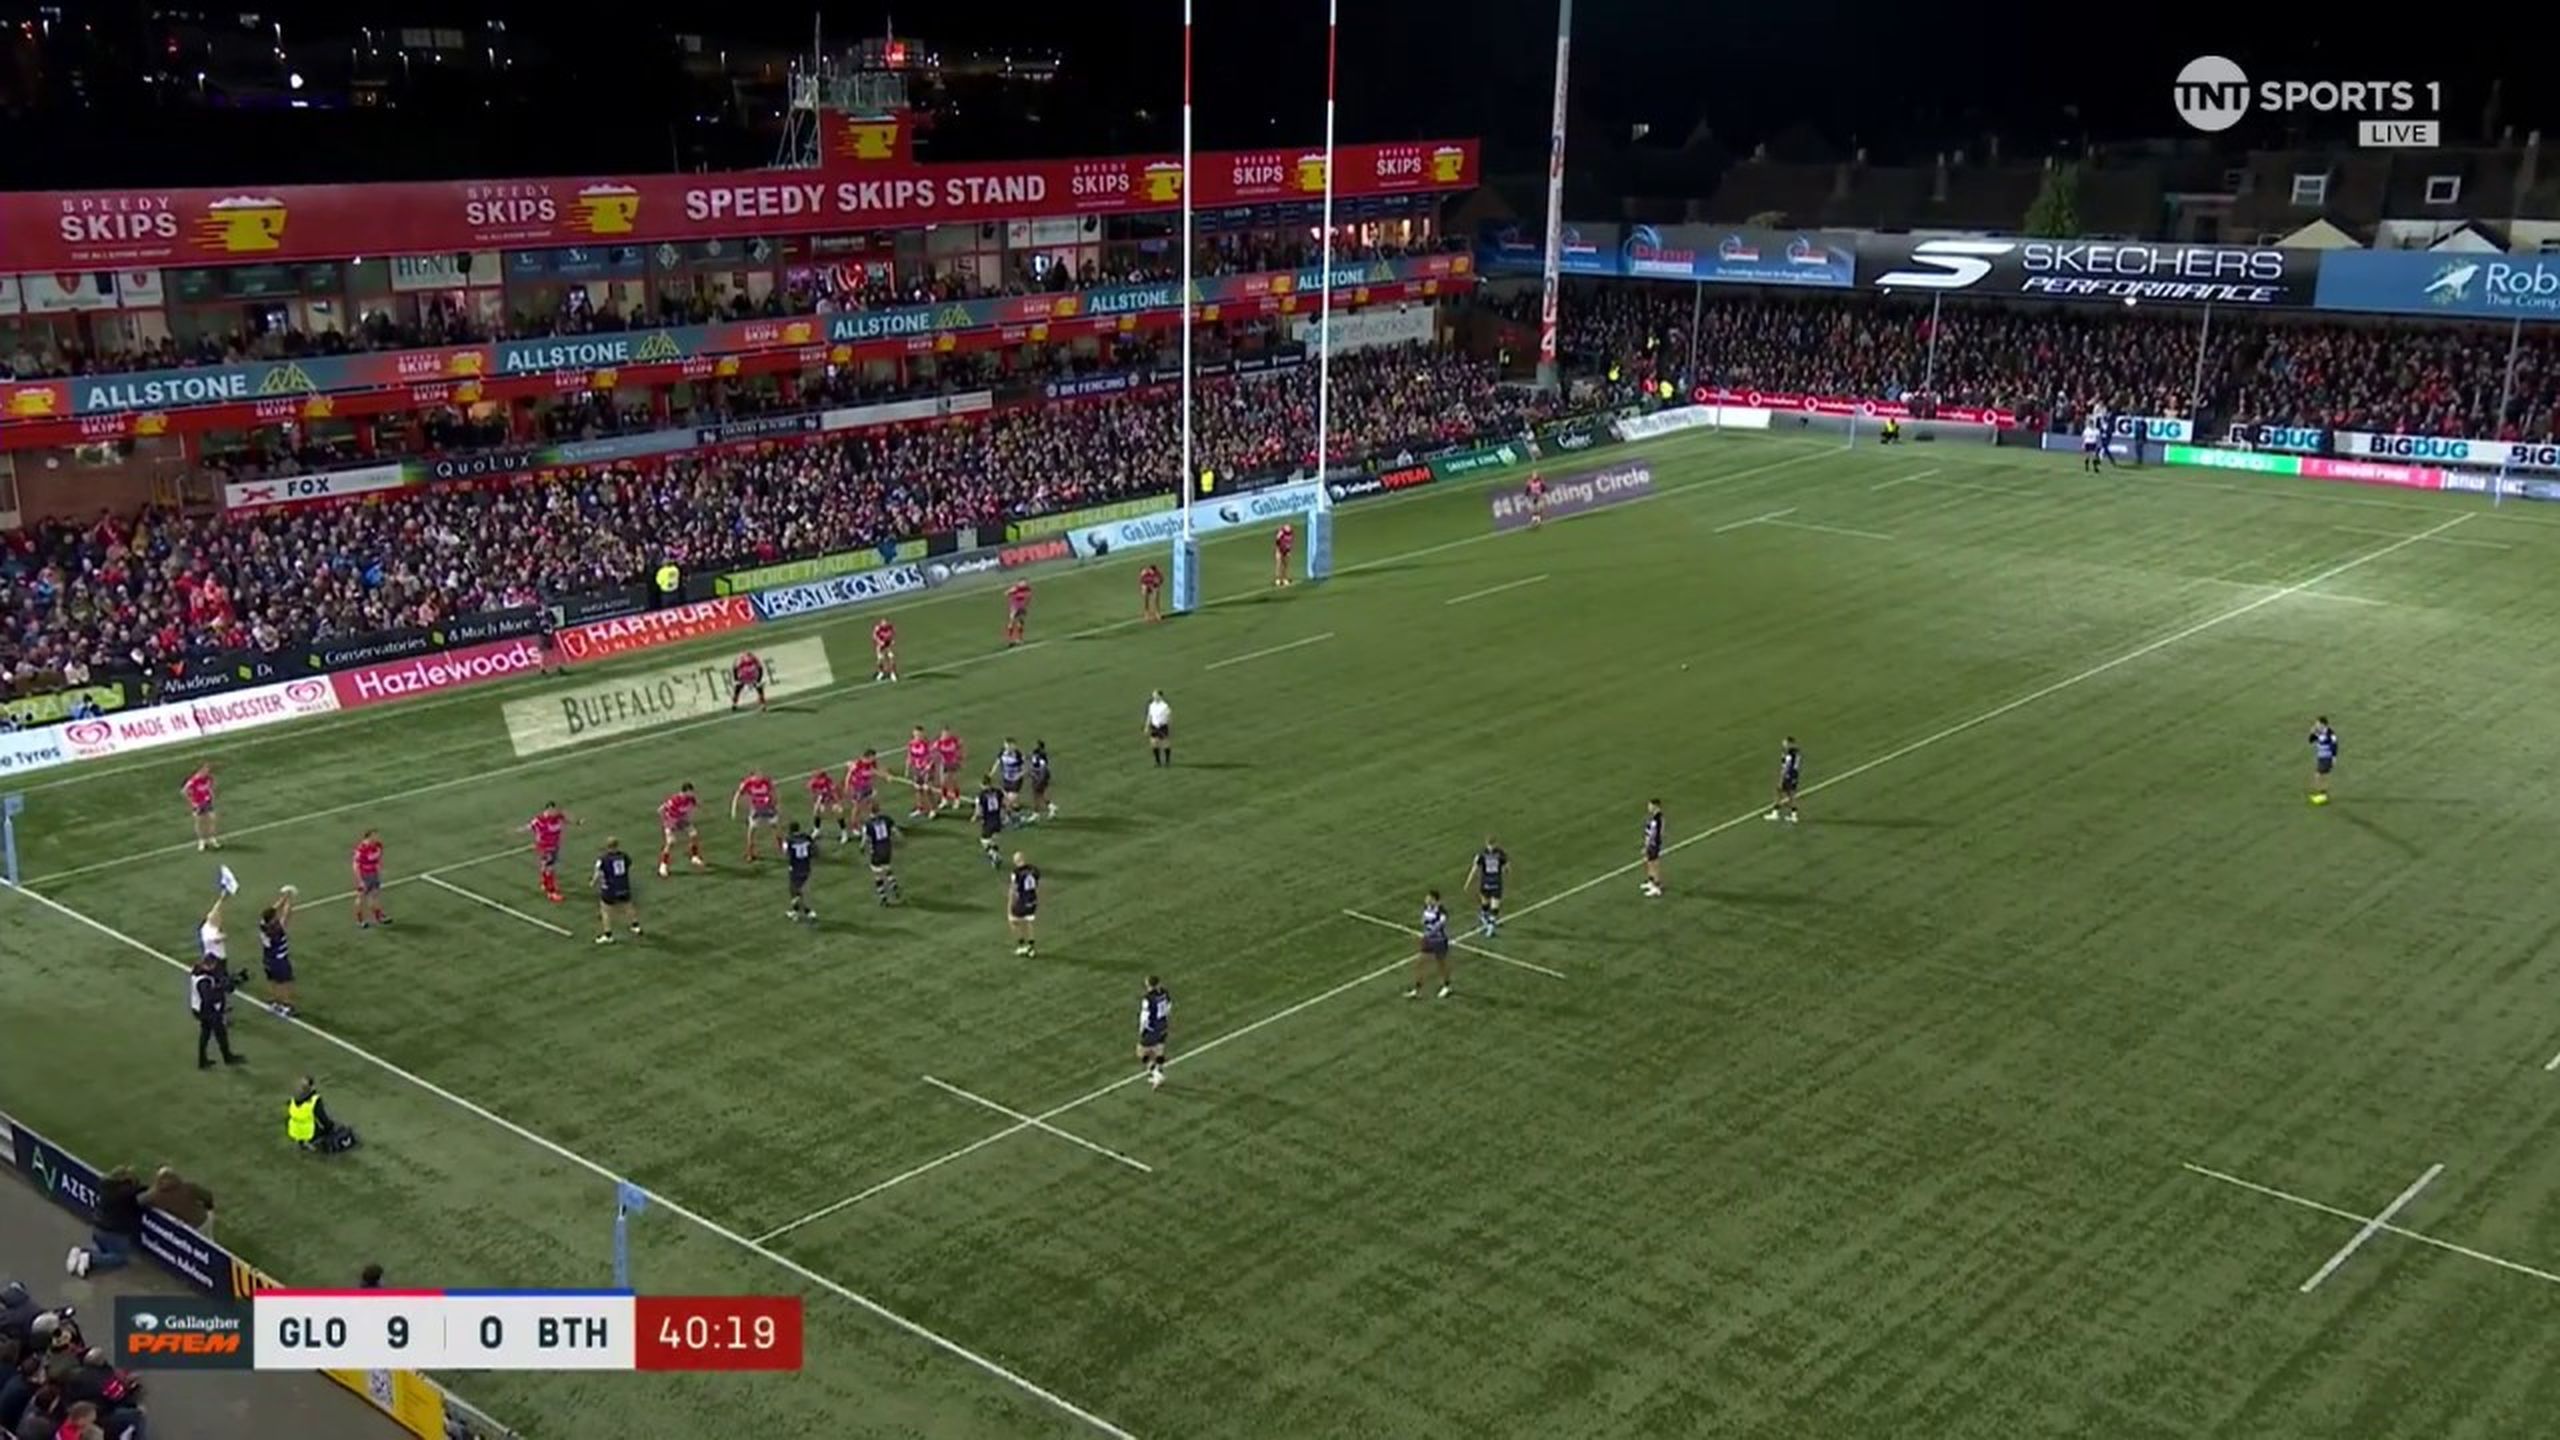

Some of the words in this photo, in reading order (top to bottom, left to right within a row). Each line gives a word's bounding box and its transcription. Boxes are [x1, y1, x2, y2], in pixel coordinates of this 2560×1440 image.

[1233, 165, 1284, 185] SKIPS
[1376, 157, 1422, 176] SKIPS
[466, 184, 550, 200] SPEEDY
[1072, 173, 1130, 195] SKIPS
[62, 195, 170, 213] SPEEDY
[686, 183, 826, 221] SPEEDY
[837, 179, 935, 212] SKIPS
[946, 174, 1046, 206] STAND
[466, 199, 557, 225] SKIPS
[60, 211, 178, 242] SKIPS
[2022, 243, 2284, 280] SKECHERS
[1091, 290, 1169, 314] ALLSTONE
[2021, 276, 2281, 302] PERFORMANCE
[834, 313, 930, 340] ALLSTONE
[507, 341, 629, 370] ALLSTONE
[86, 374, 248, 409] ALLSTONE
[81, 421, 125, 435] SKIPS
[287, 476, 330, 497] FOX
[1595, 467, 1651, 494] Circle
[1251, 491, 1318, 517] Gallagher
[461, 623, 498, 640] Much
[499, 617, 532, 634] More
[586, 597, 731, 643] HARTPURY
[597, 618, 733, 654] UNIVERSITY
[325, 635, 427, 665] Conservatories
[354, 641, 542, 699] Hazlewoods
[120, 718, 168, 741] MADE
[172, 714, 188, 730] IN
[193, 693, 286, 727] GLOUCESTER
[561, 679, 675, 734] BUFFALO
[14, 745, 61, 766] Tyres
